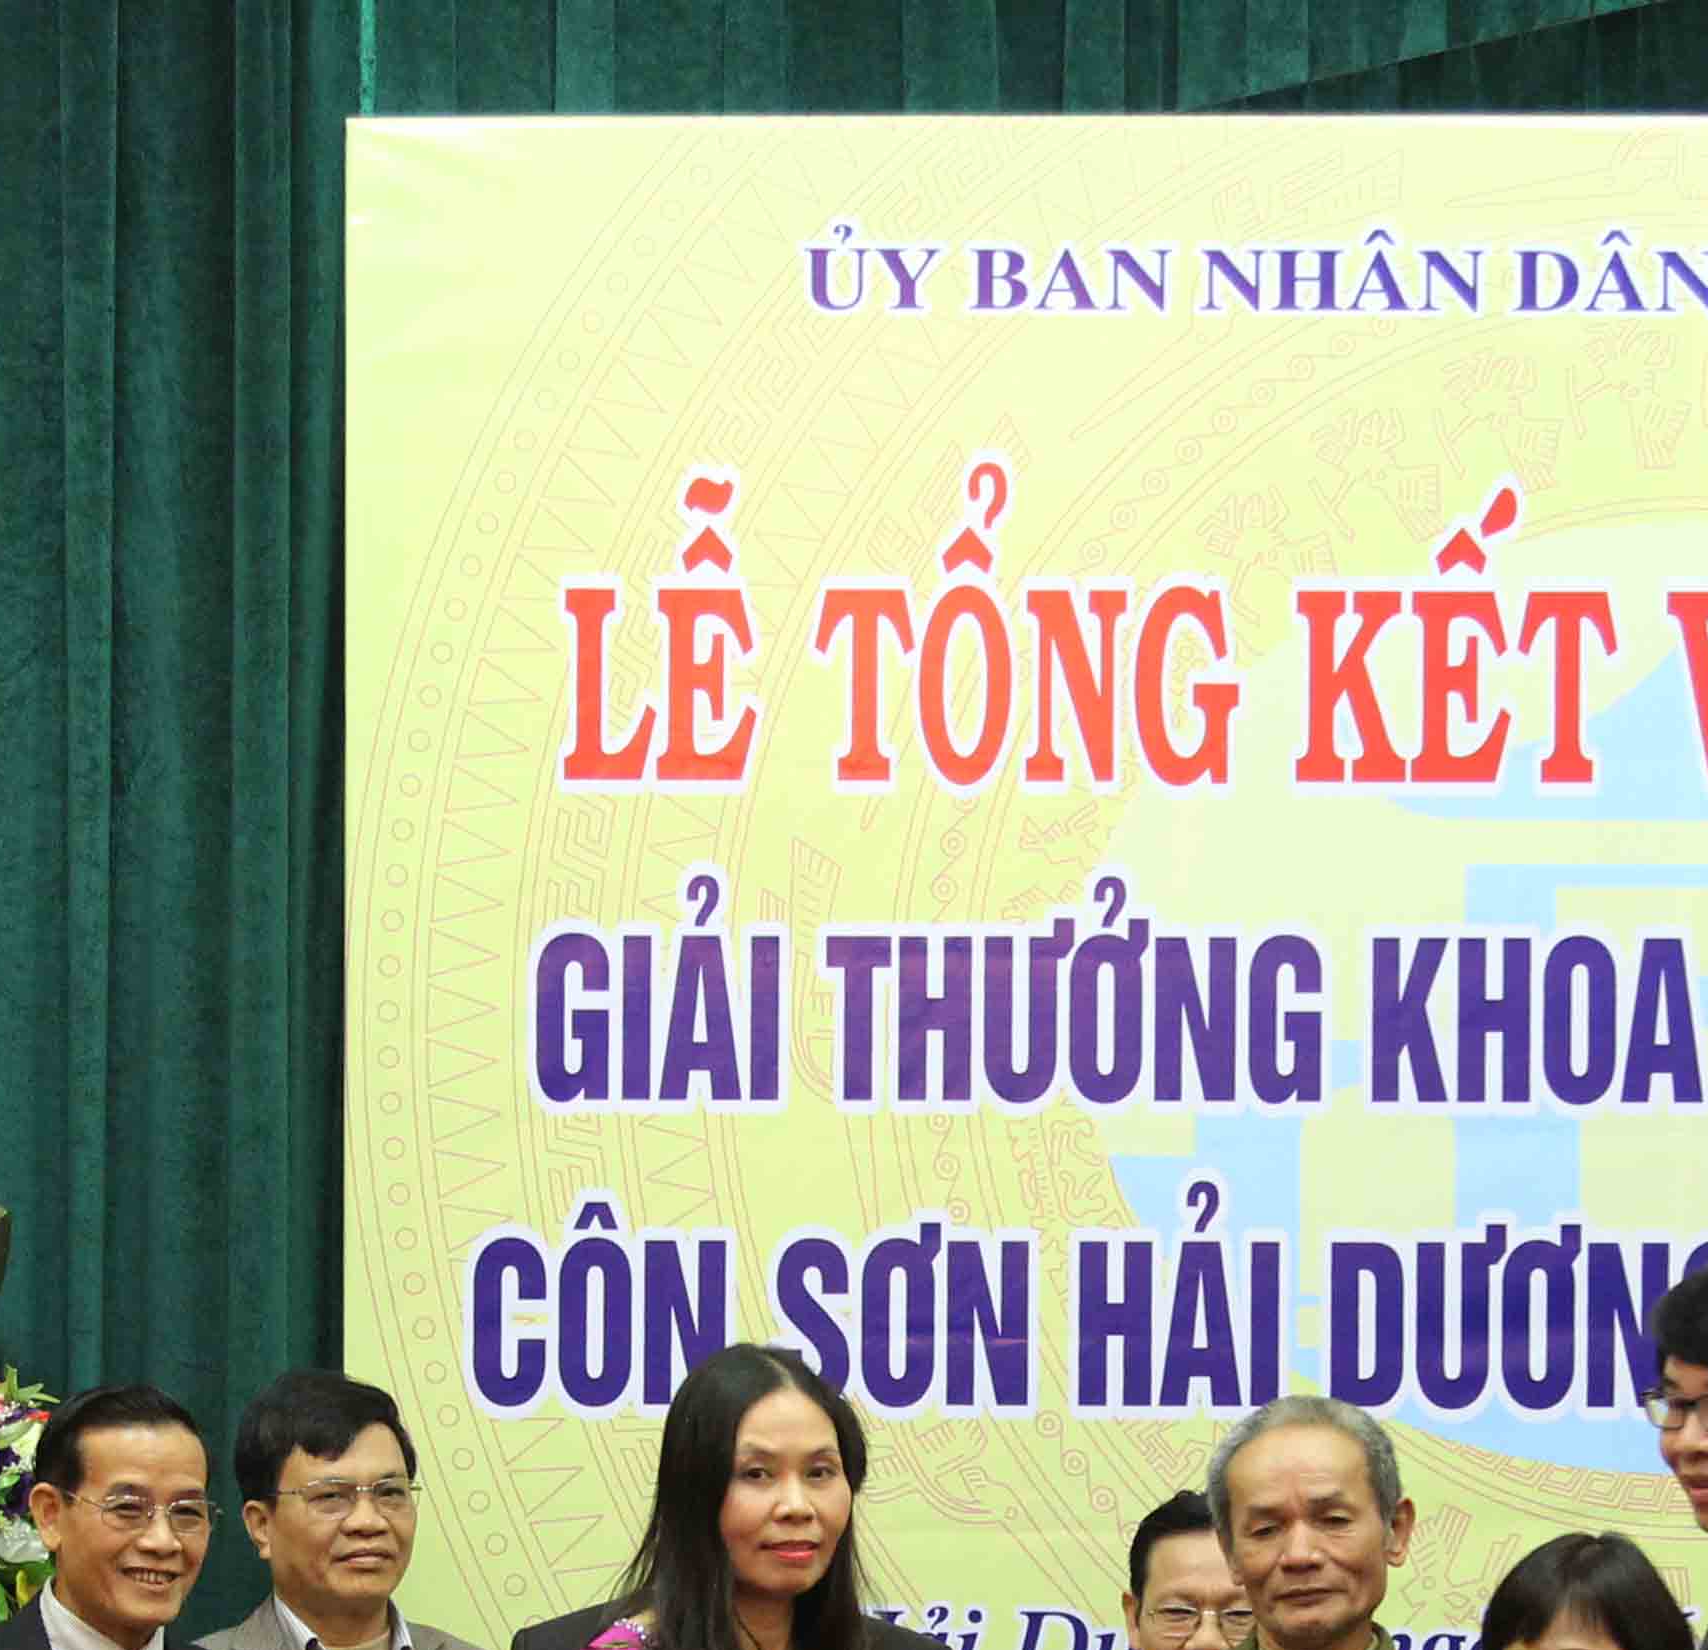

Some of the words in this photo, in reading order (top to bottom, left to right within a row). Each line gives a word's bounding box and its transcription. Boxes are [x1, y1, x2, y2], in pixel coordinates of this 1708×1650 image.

[811, 227, 935, 309] ỦY
[977, 250, 1166, 308] BAN
[1206, 230, 1476, 310] NHÂN
[564, 479, 756, 780] LỄ
[816, 464, 1239, 785] TỔNG
[1296, 489, 1616, 783] KẾT
[536, 876, 779, 1102] GIẢI
[826, 877, 1322, 1104] THƯỞNG
[1372, 936, 1702, 1105] KHOA
[473, 1202, 726, 1407] CÔN
[777, 1222, 1028, 1408] SƠN
[1078, 1183, 1280, 1408] HẢI
